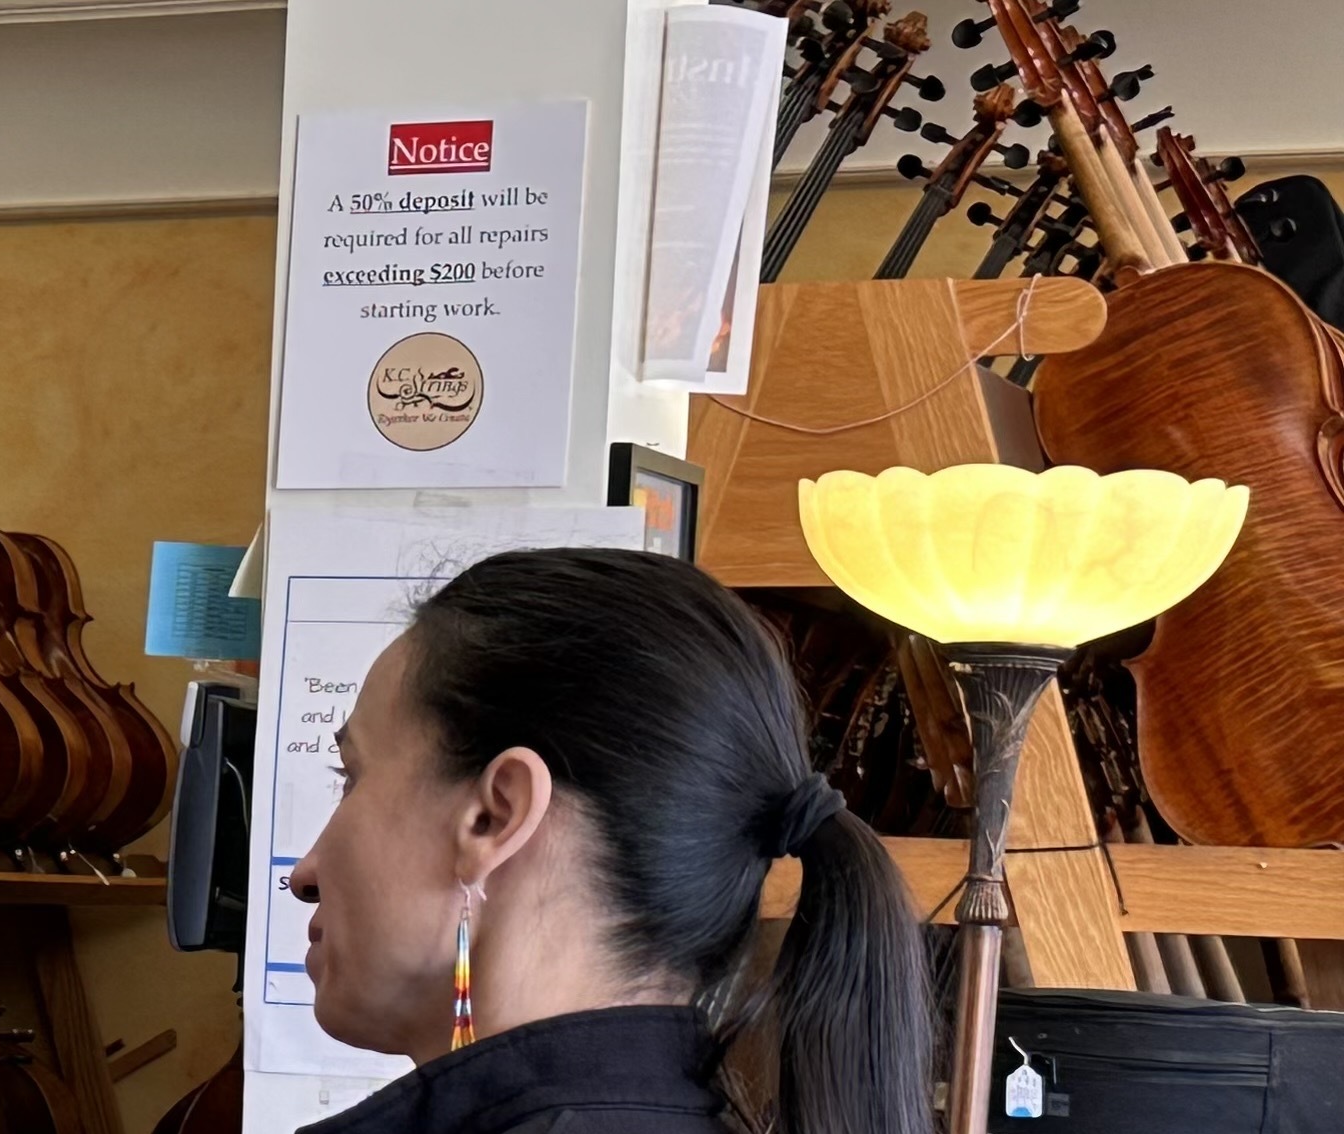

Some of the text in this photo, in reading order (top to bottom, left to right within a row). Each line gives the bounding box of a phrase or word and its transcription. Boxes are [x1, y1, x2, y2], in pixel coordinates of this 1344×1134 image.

[391, 136, 490, 165] Notice
[327, 187, 548, 214] A 50% deposit will be
[324, 225, 549, 254] required for all repairs
[323, 259, 545, 286] exceeding $200 before
[360, 298, 501, 323] starting work.
[301, 706, 335, 723] and
[287, 735, 321, 753] and
